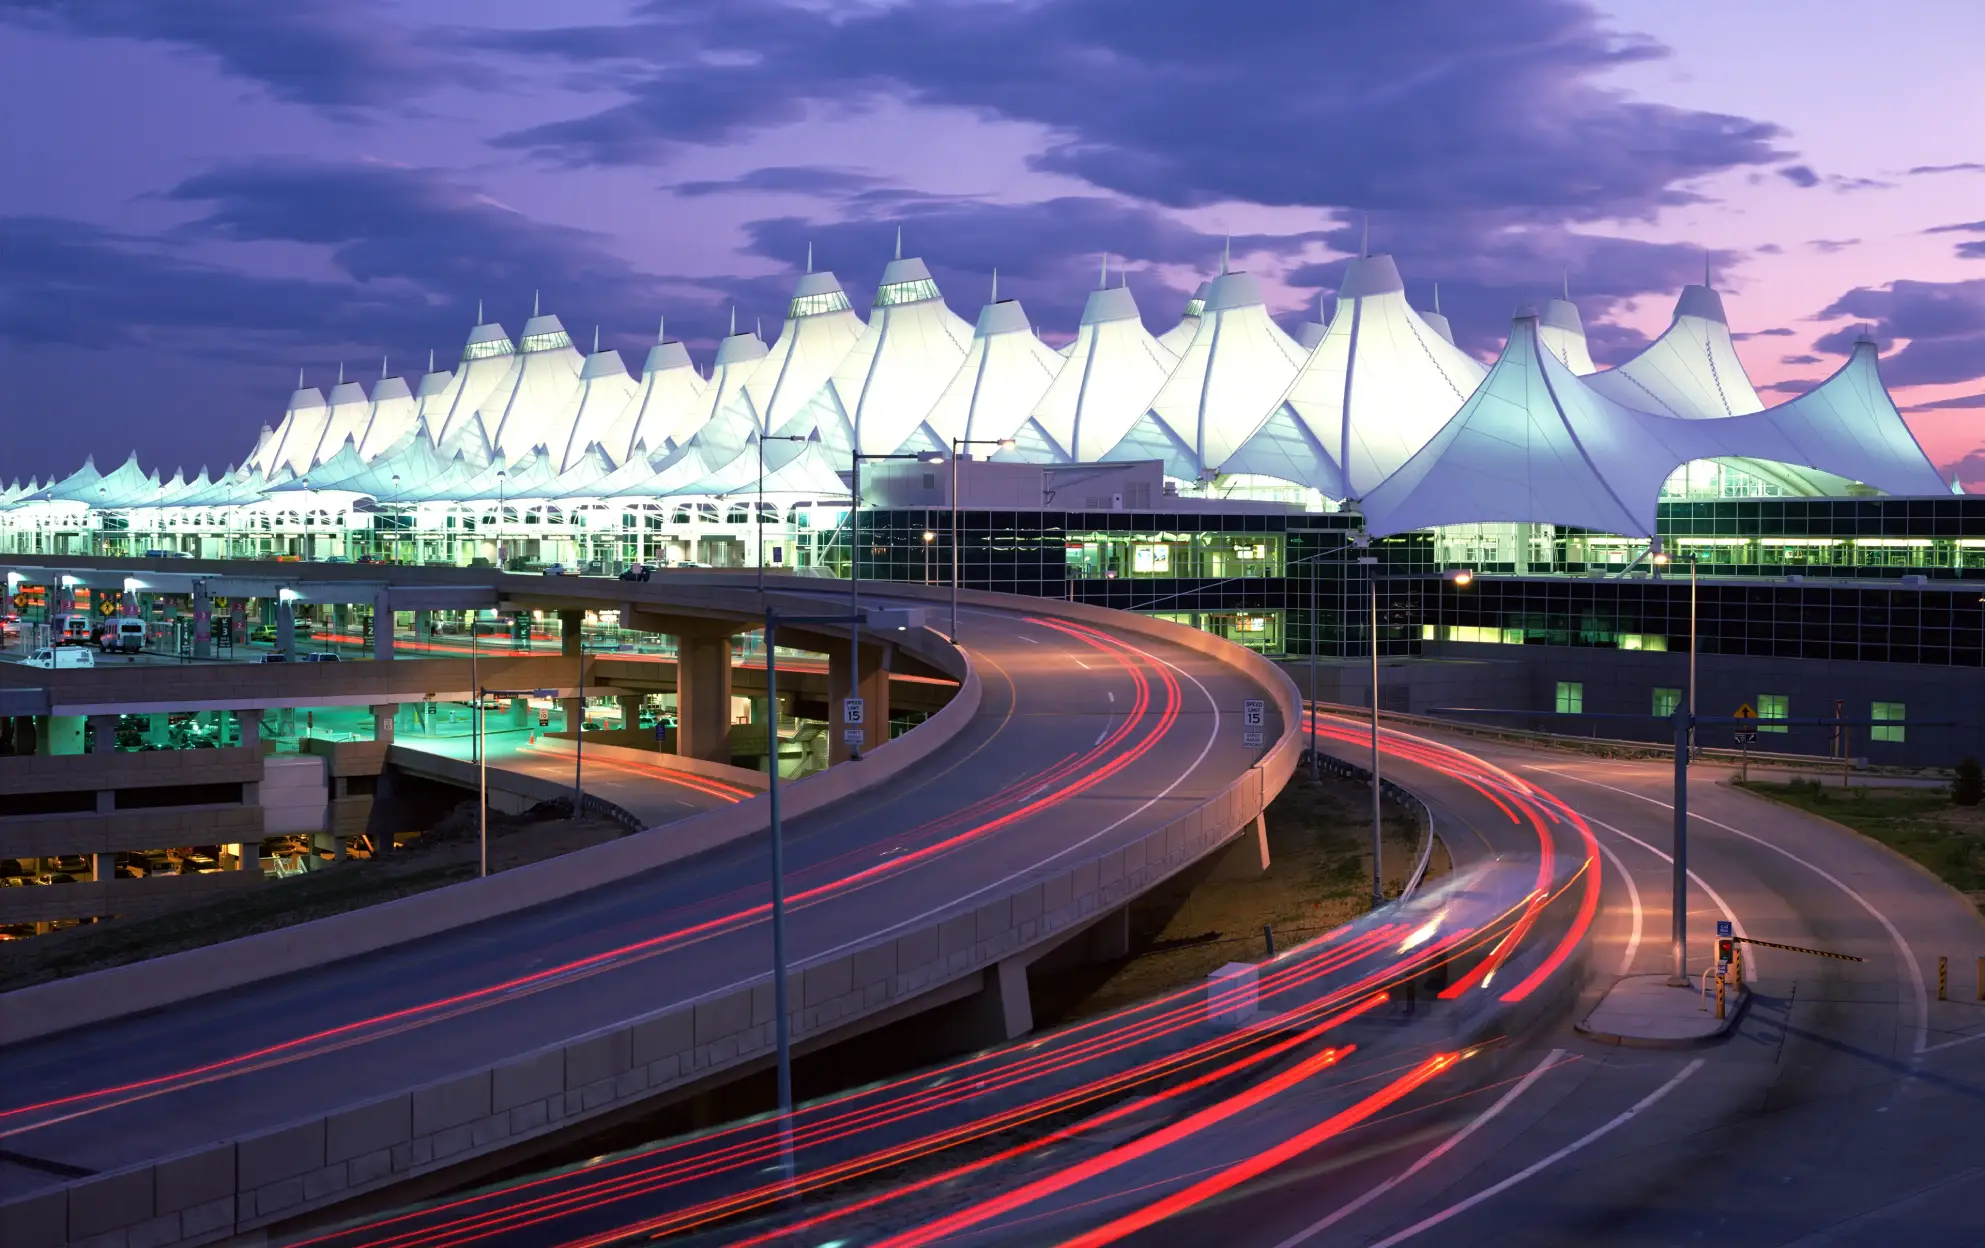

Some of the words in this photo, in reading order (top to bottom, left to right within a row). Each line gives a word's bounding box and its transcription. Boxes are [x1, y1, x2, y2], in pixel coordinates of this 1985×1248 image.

[222, 628, 228, 636] 3
[368, 626, 374, 635] 2
[848, 711, 860, 721] 15
[1248, 713, 1260, 723] 15
